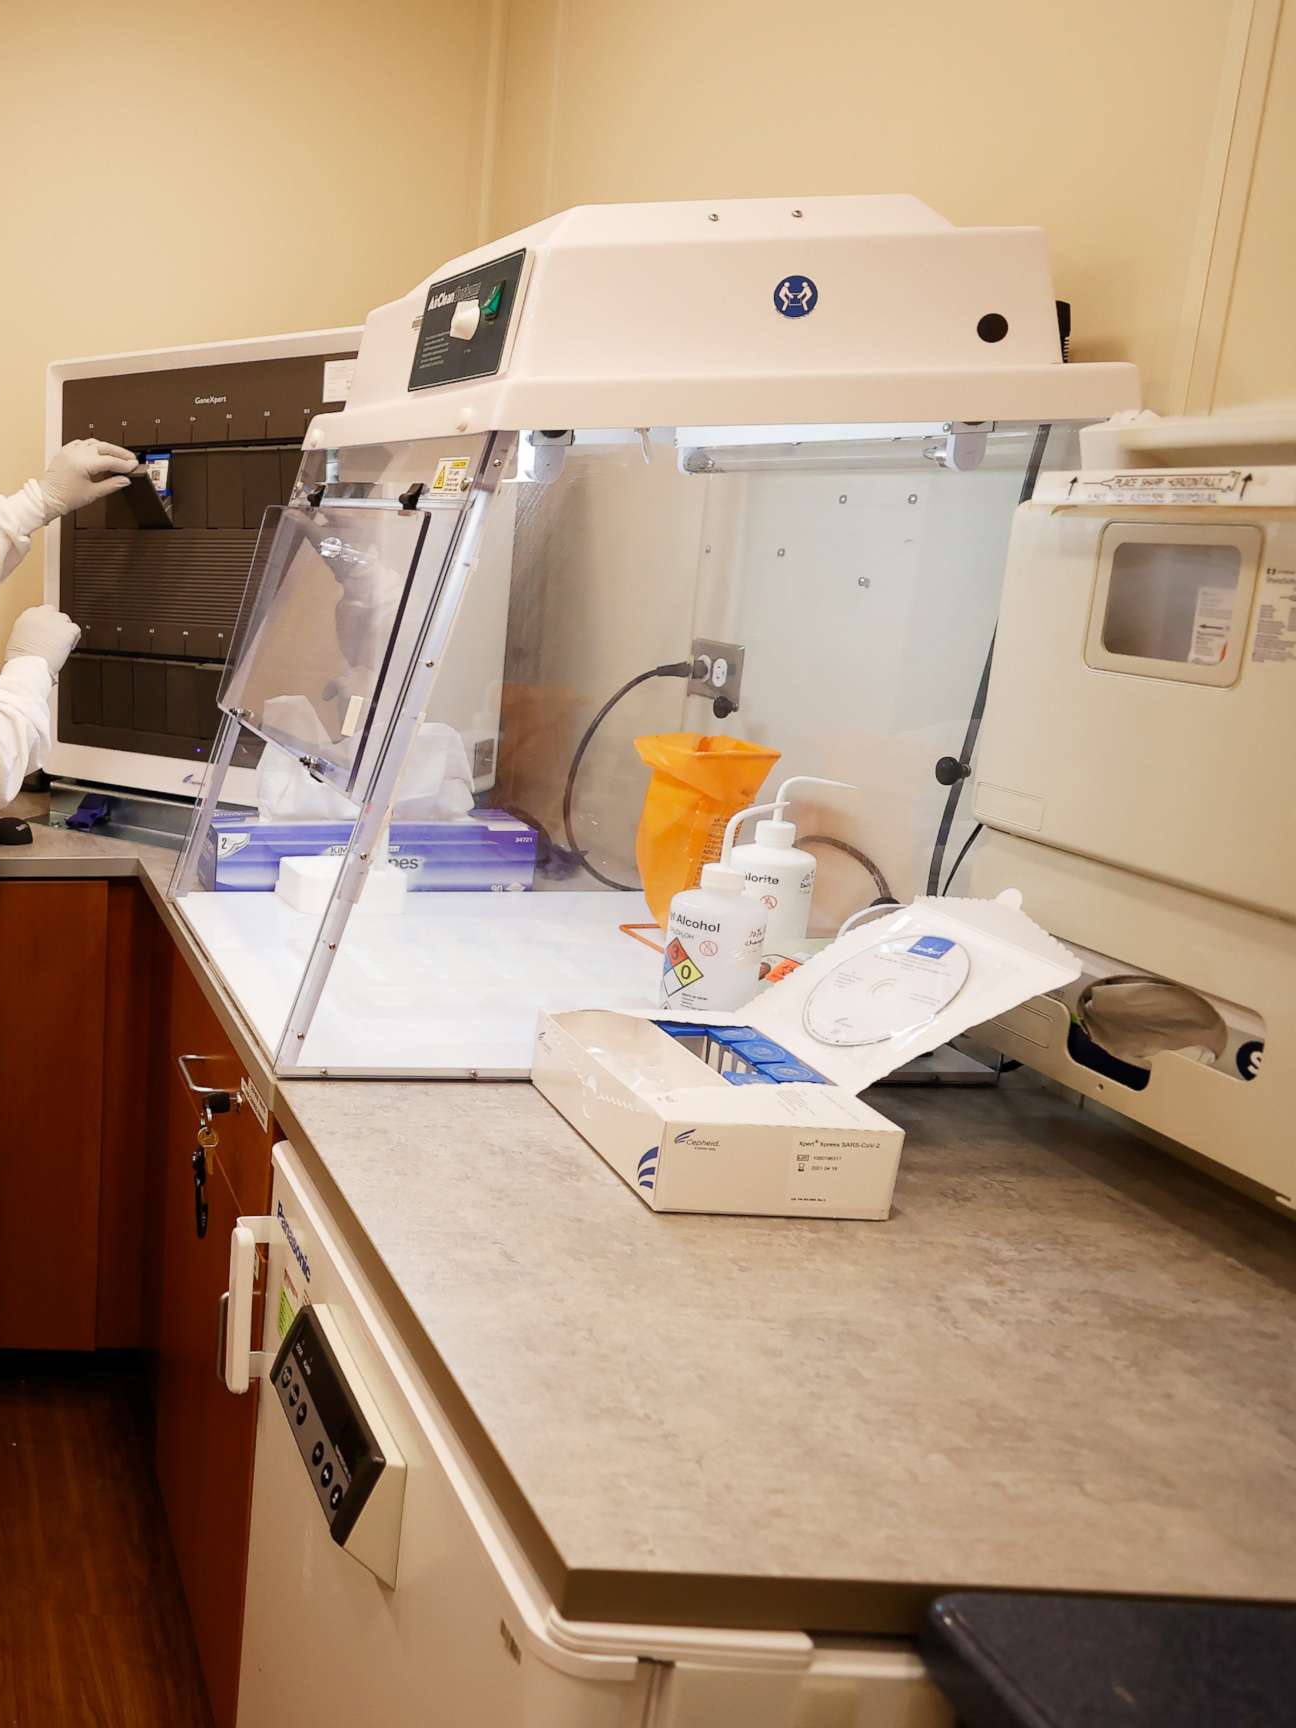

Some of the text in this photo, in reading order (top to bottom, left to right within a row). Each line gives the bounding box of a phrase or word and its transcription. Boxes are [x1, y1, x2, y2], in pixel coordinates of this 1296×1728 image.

[427, 291, 456, 312] AirClean
[194, 396, 227, 405] GeneXpert
[221, 837, 228, 850] 2
[677, 913, 721, 933] Alcohol
[680, 964, 692, 980] 0
[276, 1199, 312, 1284] Panasonic
